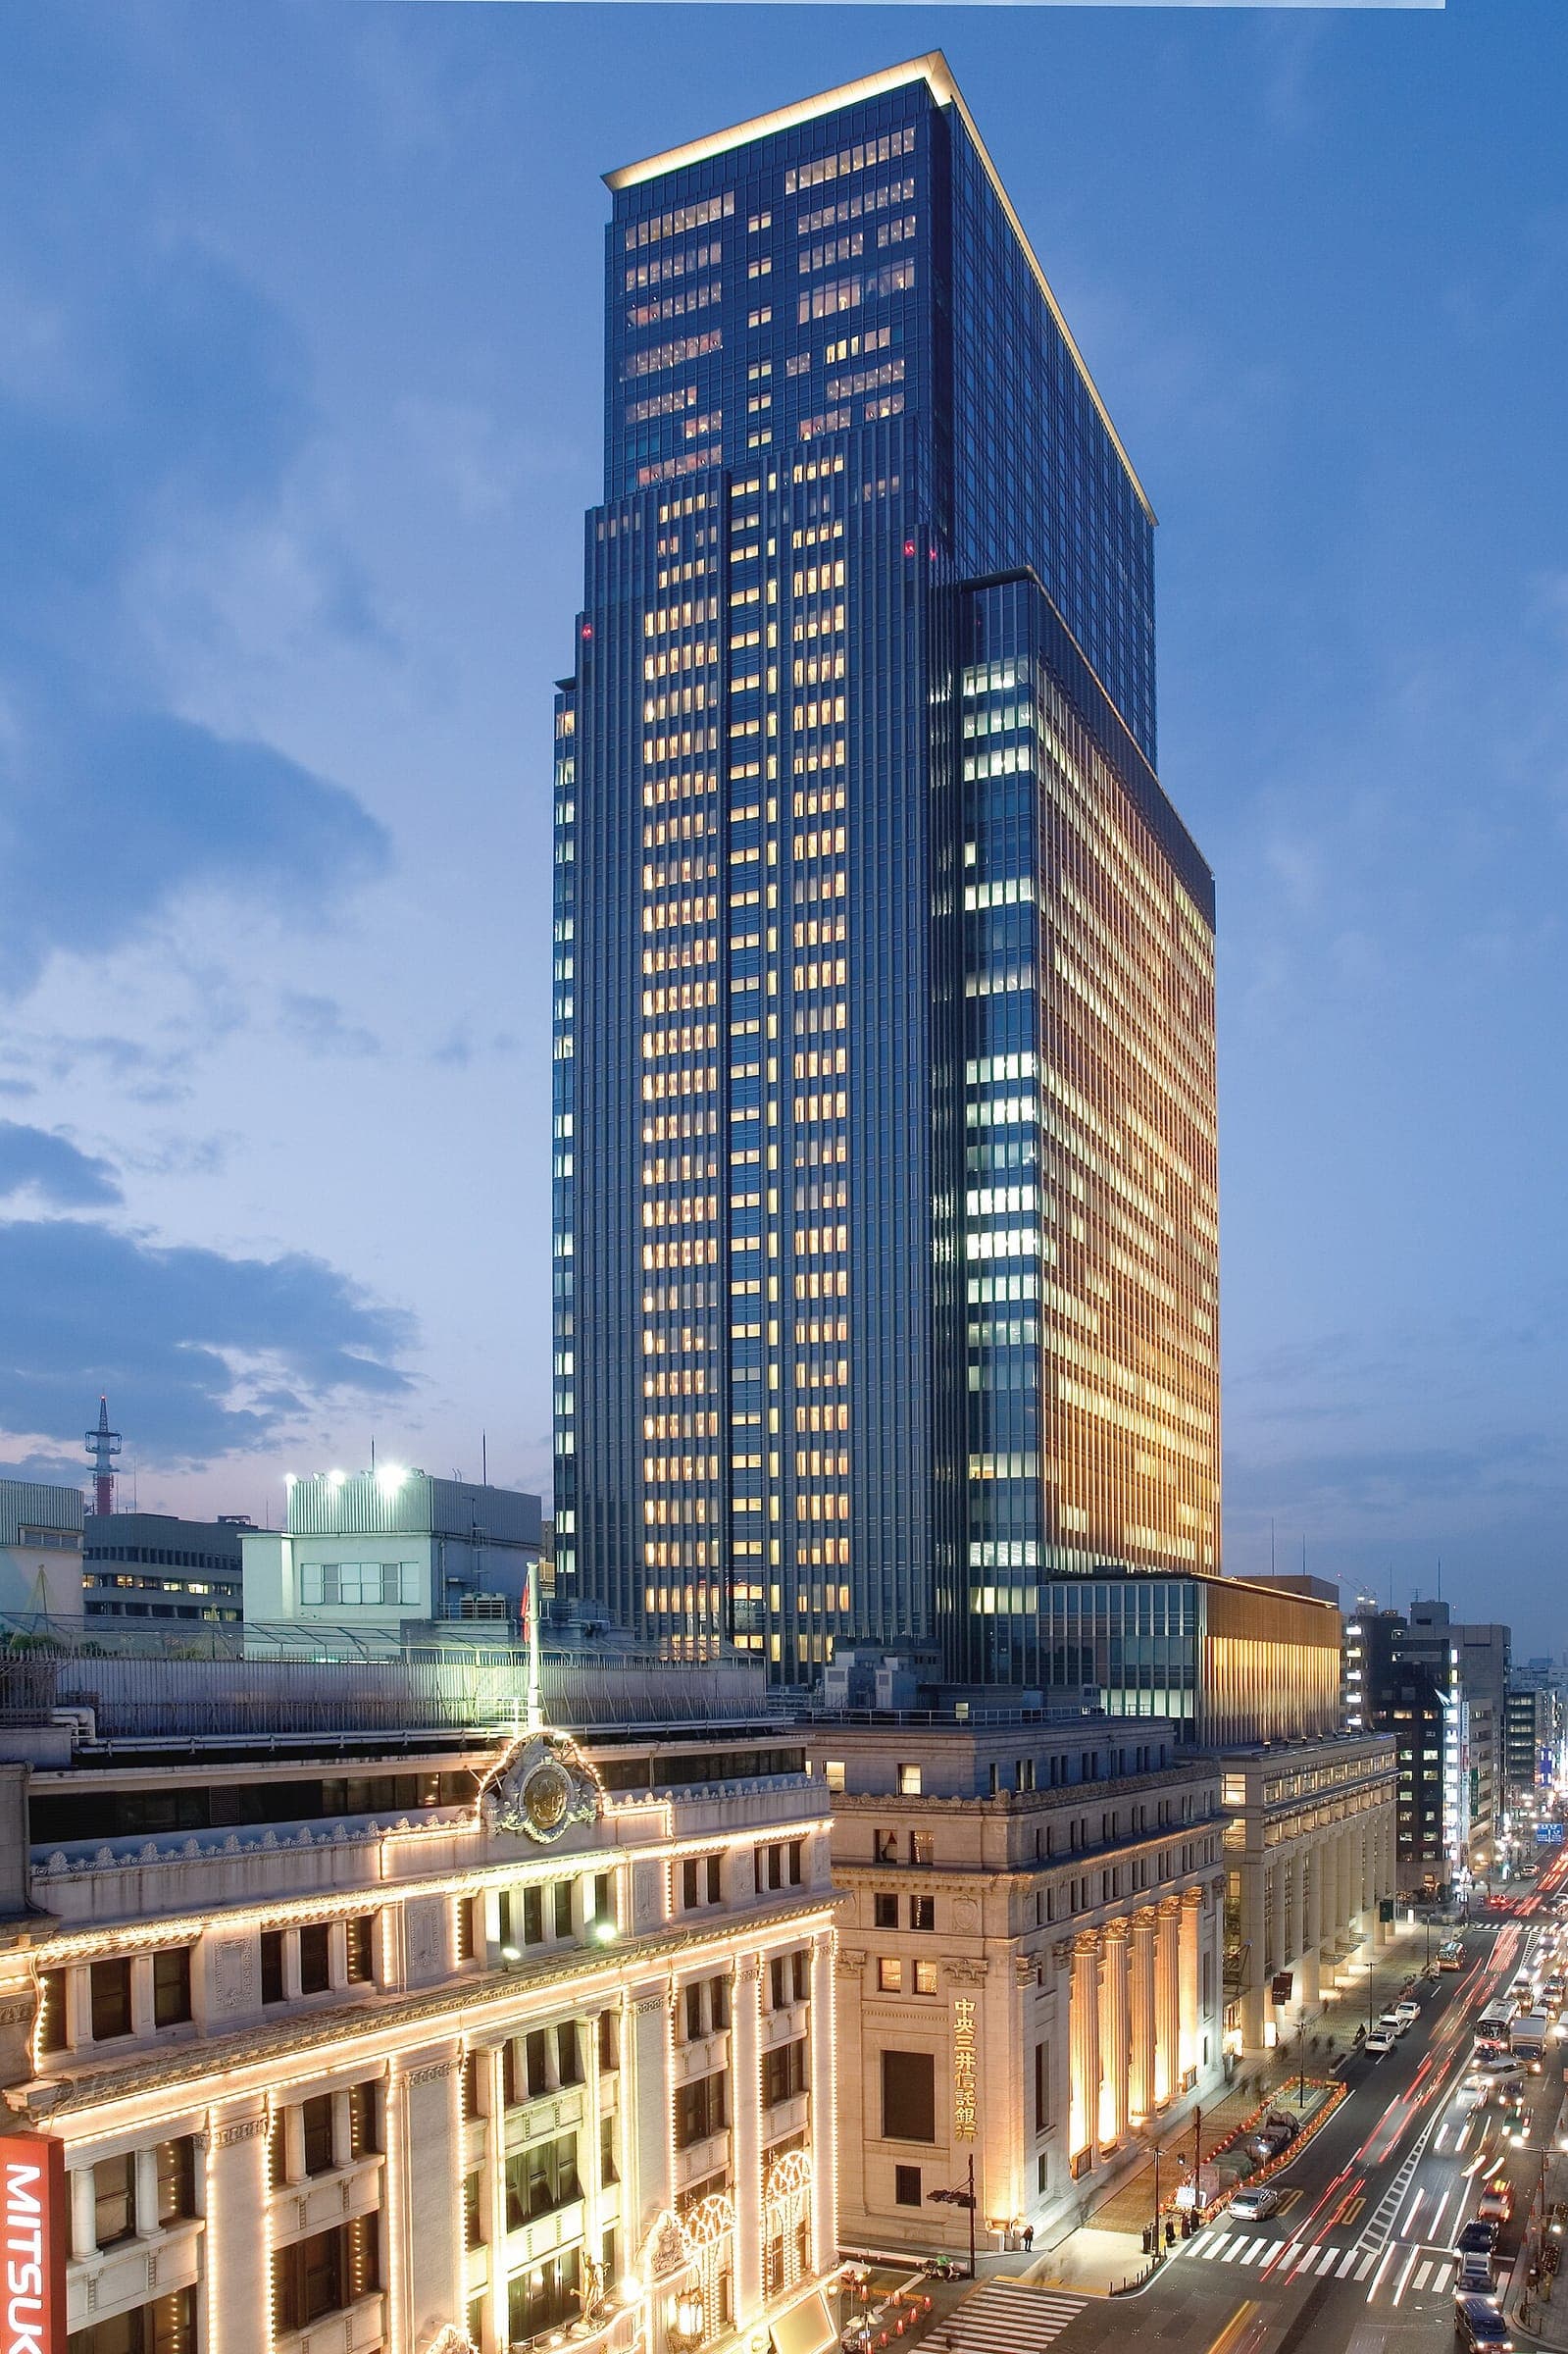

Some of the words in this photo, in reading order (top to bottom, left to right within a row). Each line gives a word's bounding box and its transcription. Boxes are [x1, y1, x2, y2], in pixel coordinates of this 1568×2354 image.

[953, 1998, 978, 2142] 中央三井信託銀行
